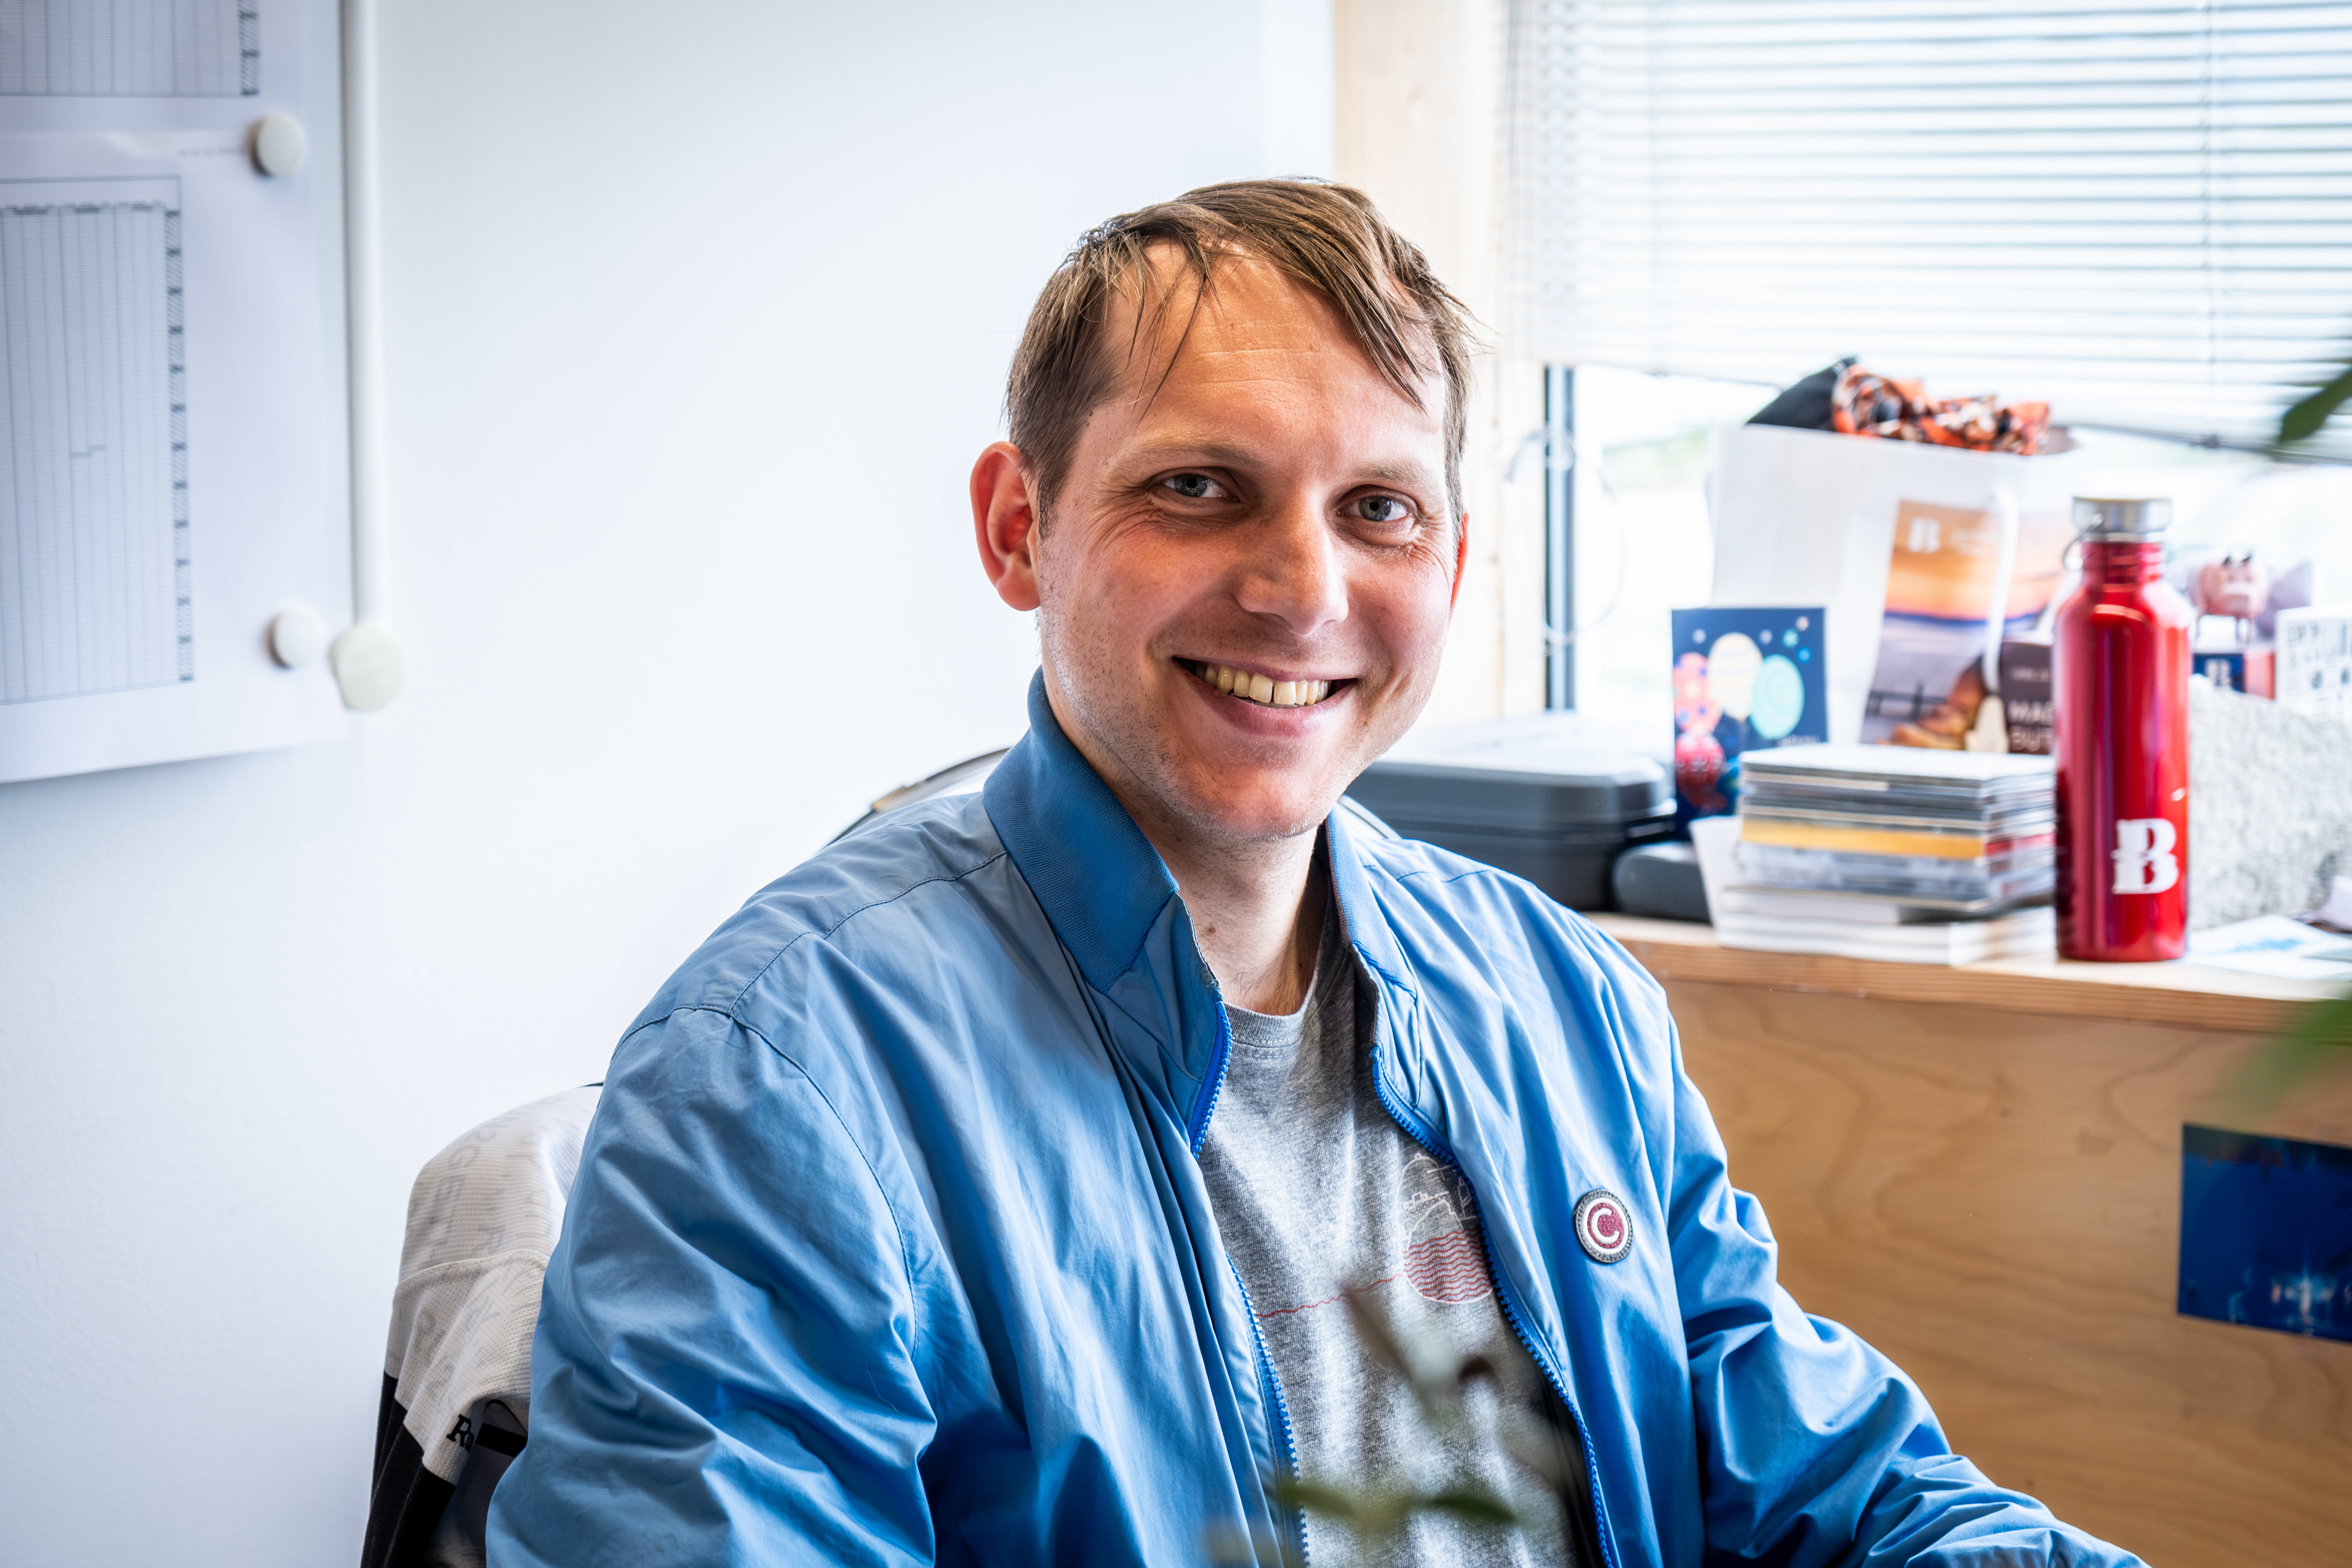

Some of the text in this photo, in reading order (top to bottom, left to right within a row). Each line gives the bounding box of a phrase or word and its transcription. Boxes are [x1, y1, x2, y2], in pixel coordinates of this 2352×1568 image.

[1908, 516, 1942, 553] B
[2110, 818, 2179, 894] B
[1591, 1207, 1620, 1244] C
